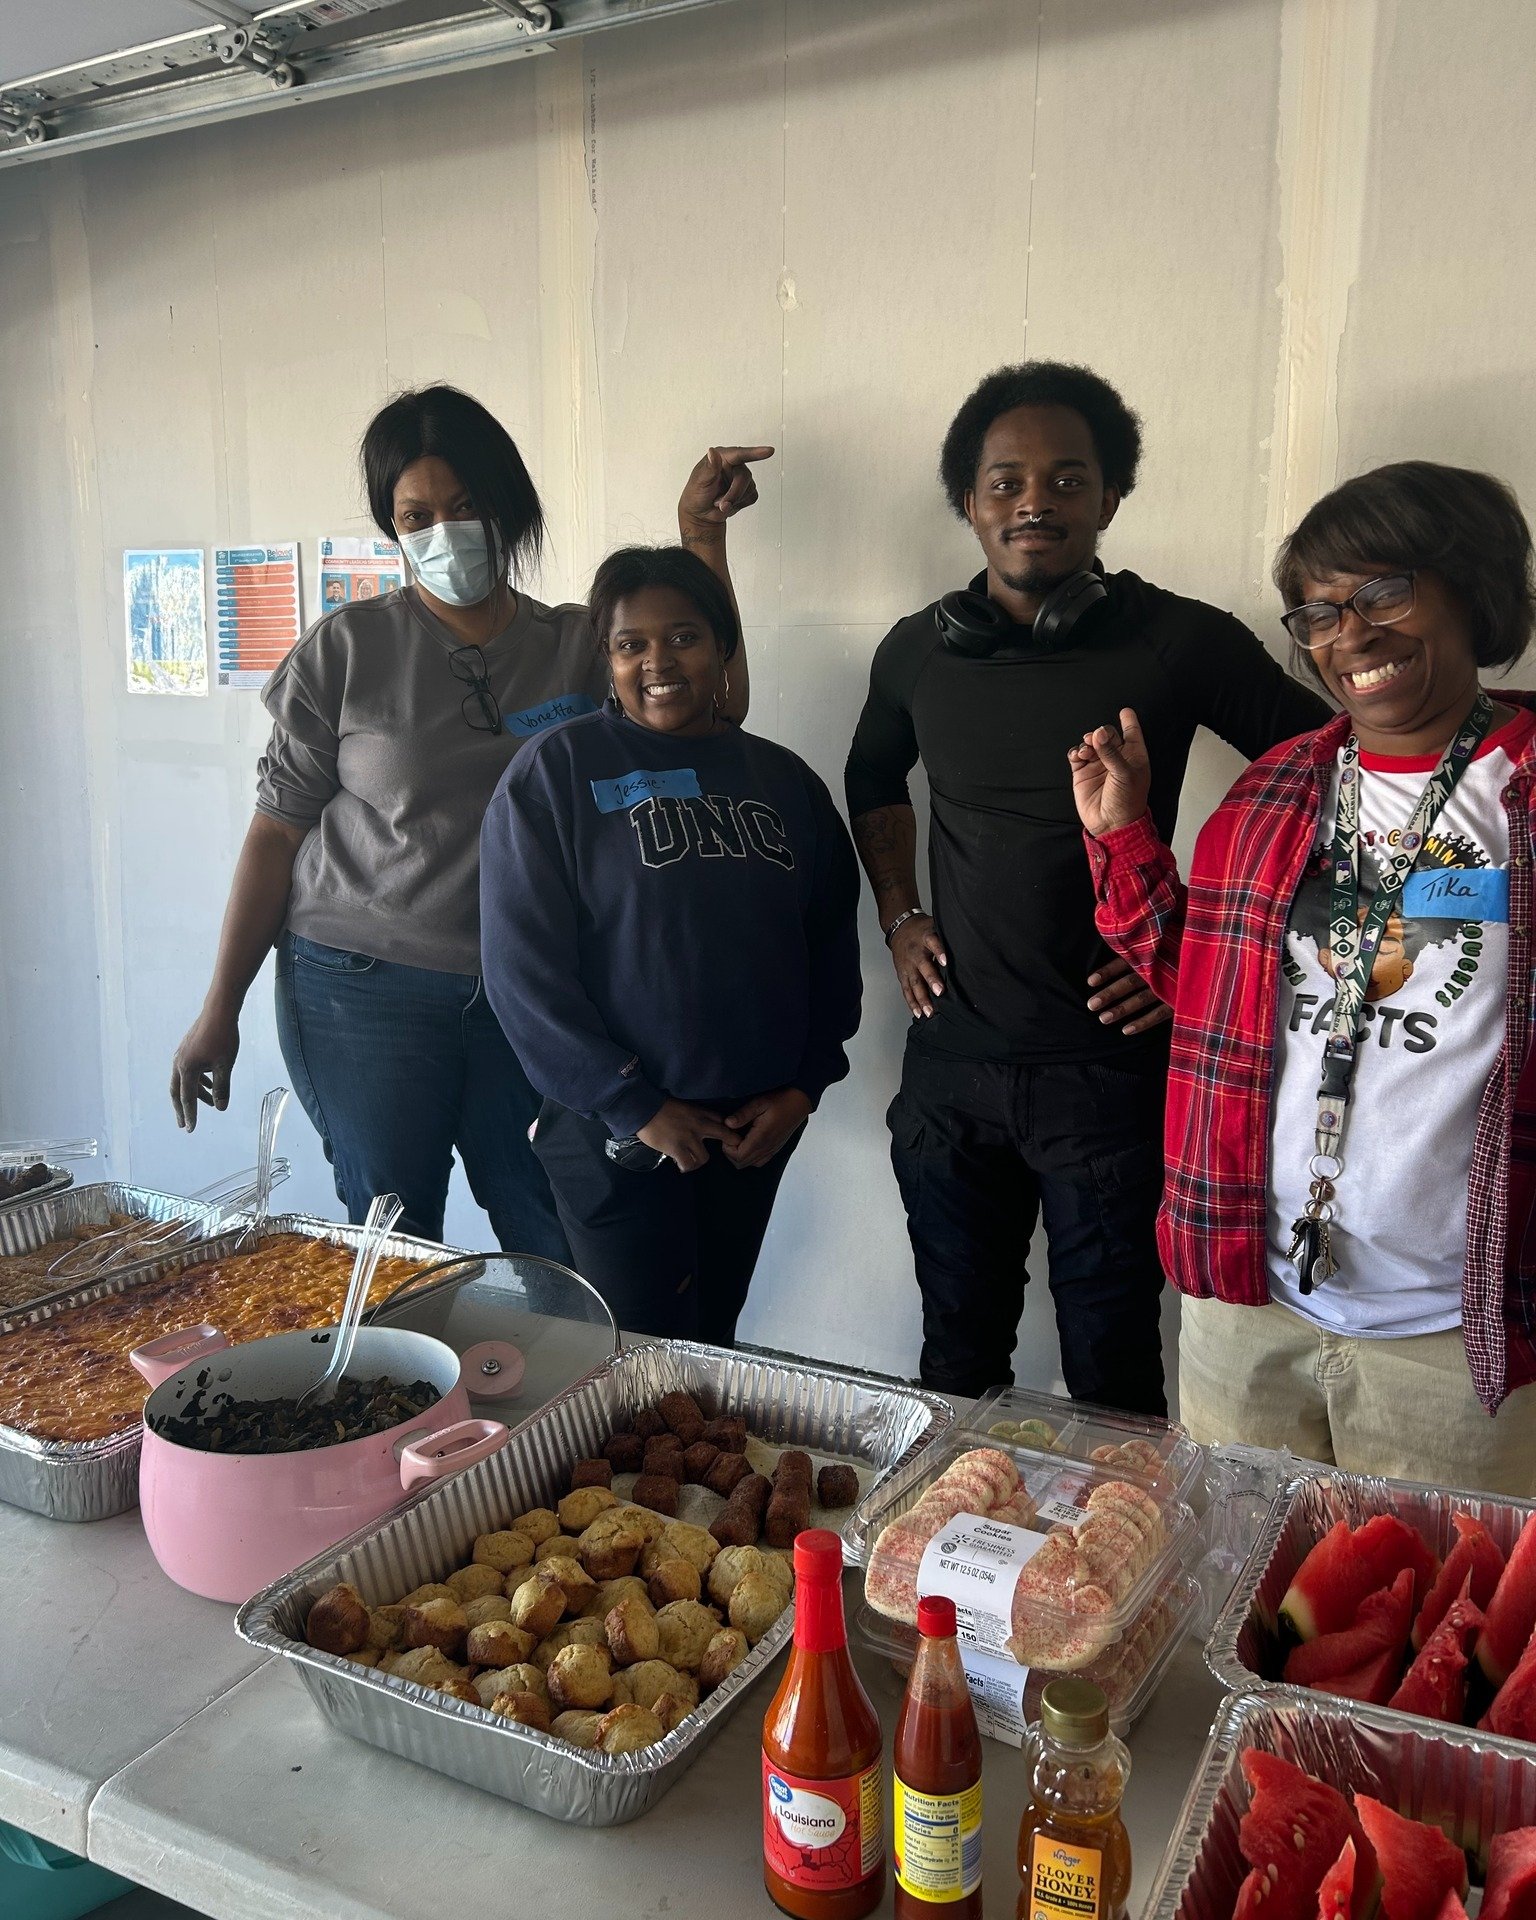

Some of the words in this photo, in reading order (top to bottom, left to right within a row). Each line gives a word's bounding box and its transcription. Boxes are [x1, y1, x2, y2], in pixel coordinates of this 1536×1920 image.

[629, 794, 795, 871] UNC
[974, 1528, 1012, 1542] Cookies
[982, 1524, 1012, 1535] Sugar
[969, 1542, 1013, 1558] GUARANTEED
[972, 1538, 1016, 1554] FRESHNESS
[939, 1558, 950, 1569] NET
[951, 1561, 960, 1571] WT
[960, 1564, 971, 1576] 12.5
[972, 1567, 979, 1578] OZ
[979, 1570, 996, 1584] (354g)
[956, 1606, 972, 1616] acts
[962, 1632, 976, 1642] 150
[904, 1790, 935, 1807] Nutrition
[780, 1804, 835, 1827] Louisiana
[791, 1824, 804, 1834] Hot
[808, 1828, 836, 1838] Sauce
[905, 1820, 931, 1835] Calories
[914, 1852, 943, 1863] Carbohydrate
[1053, 1849, 1081, 1867] Kroger
[1037, 1863, 1095, 1886] CLOVER
[1036, 1874, 1096, 1899] HONEY
